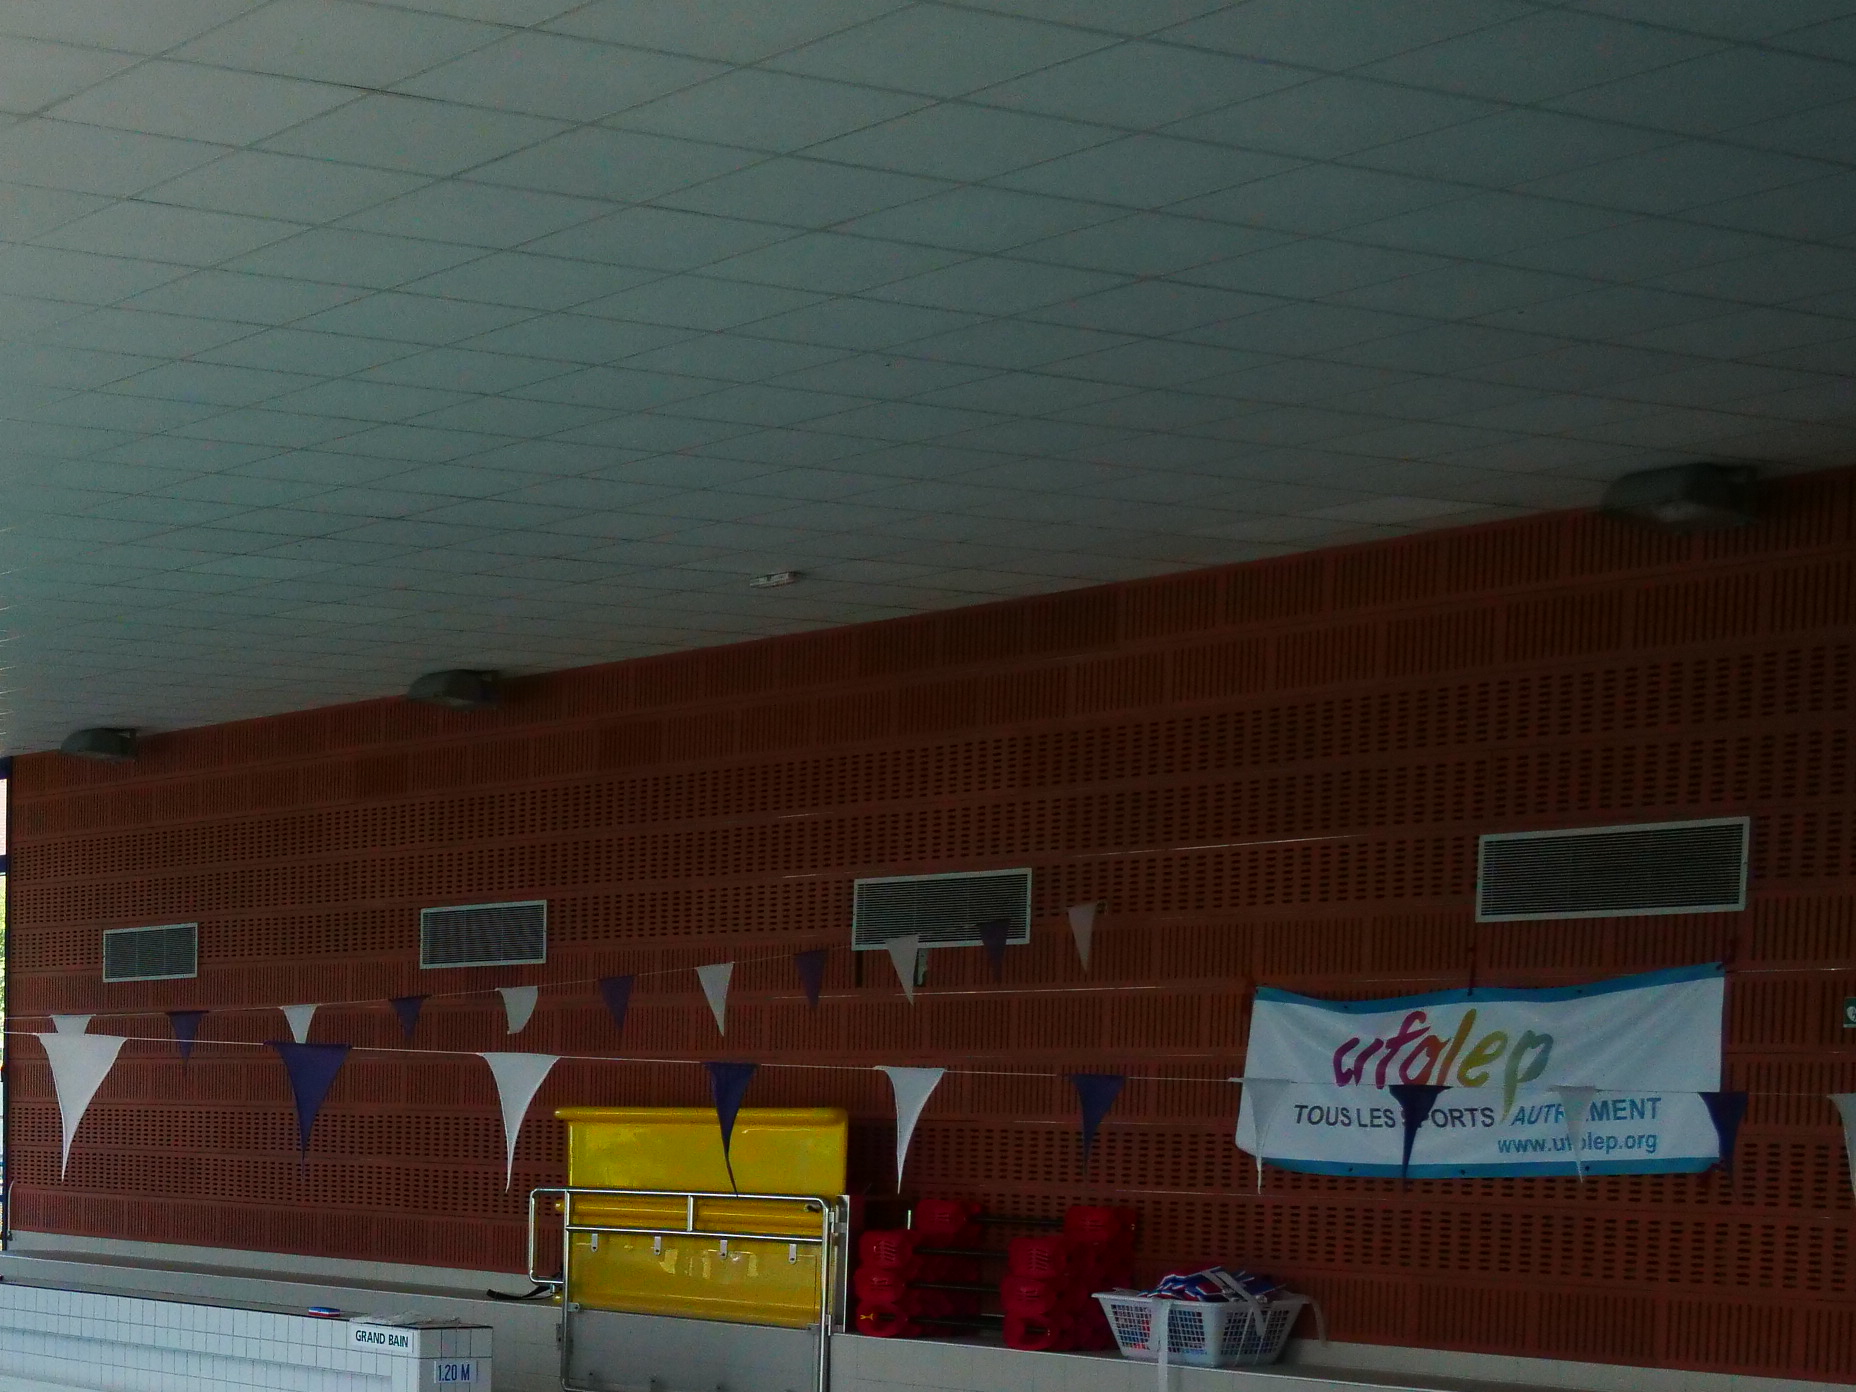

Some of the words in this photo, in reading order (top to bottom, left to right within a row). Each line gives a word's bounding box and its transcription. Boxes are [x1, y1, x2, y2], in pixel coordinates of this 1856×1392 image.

[1333, 1008, 1554, 1124] ufolep
[1294, 1105, 1351, 1127] TOUS
[1357, 1108, 1396, 1127] LES
[1510, 1097, 1662, 1126] AUTRMENT
[355, 1330, 386, 1345] GRAND
[388, 1333, 409, 1348] BAIN
[438, 1364, 458, 1382] 1.20
[460, 1364, 470, 1381] M
